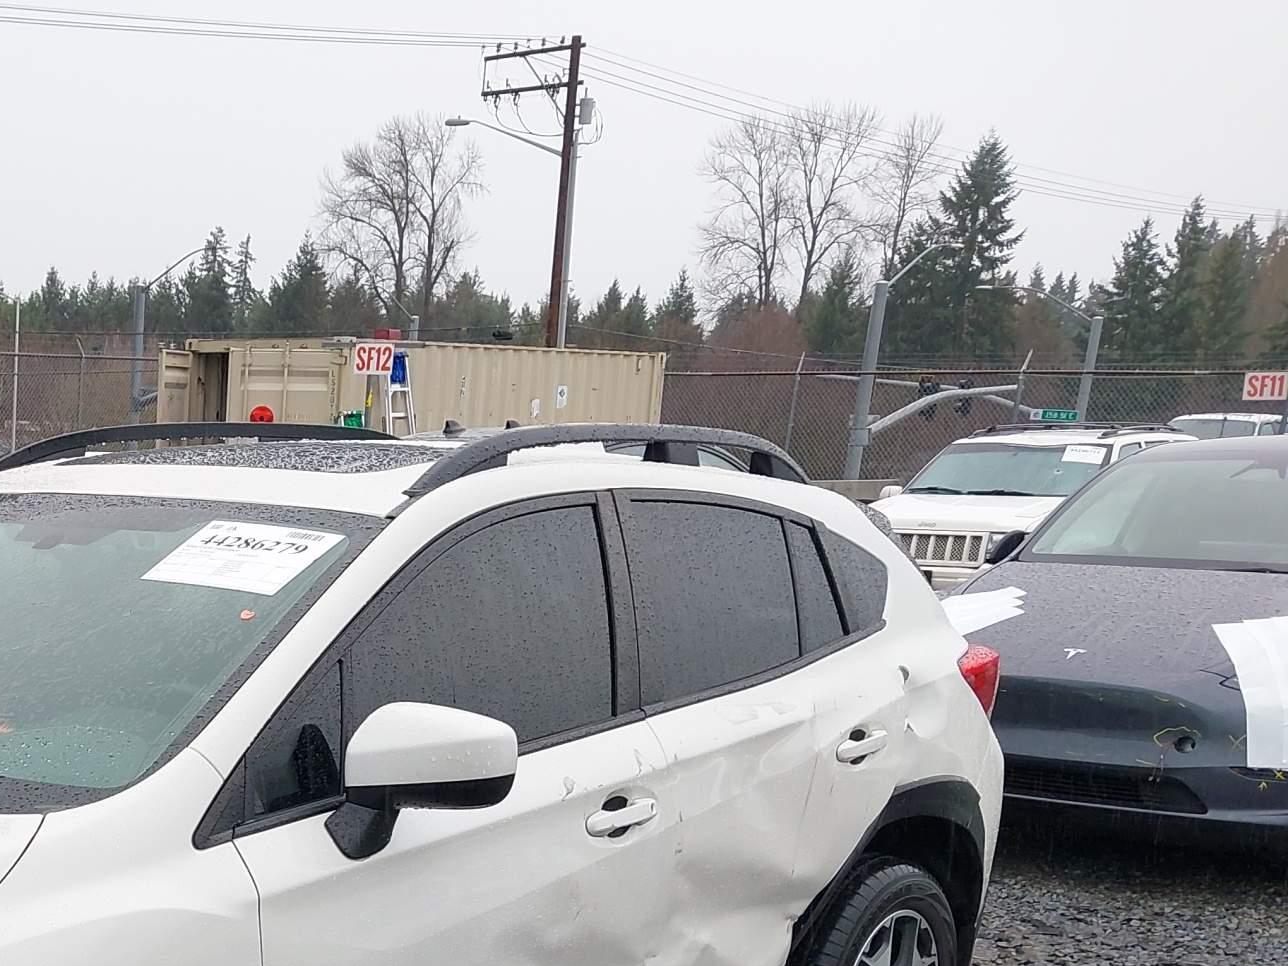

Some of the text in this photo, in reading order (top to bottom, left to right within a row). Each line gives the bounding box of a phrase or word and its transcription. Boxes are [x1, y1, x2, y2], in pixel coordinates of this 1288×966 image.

[355, 346, 393, 372] SF12
[1246, 374, 1286, 398] SF11
[200, 533, 309, 555] 44286279
